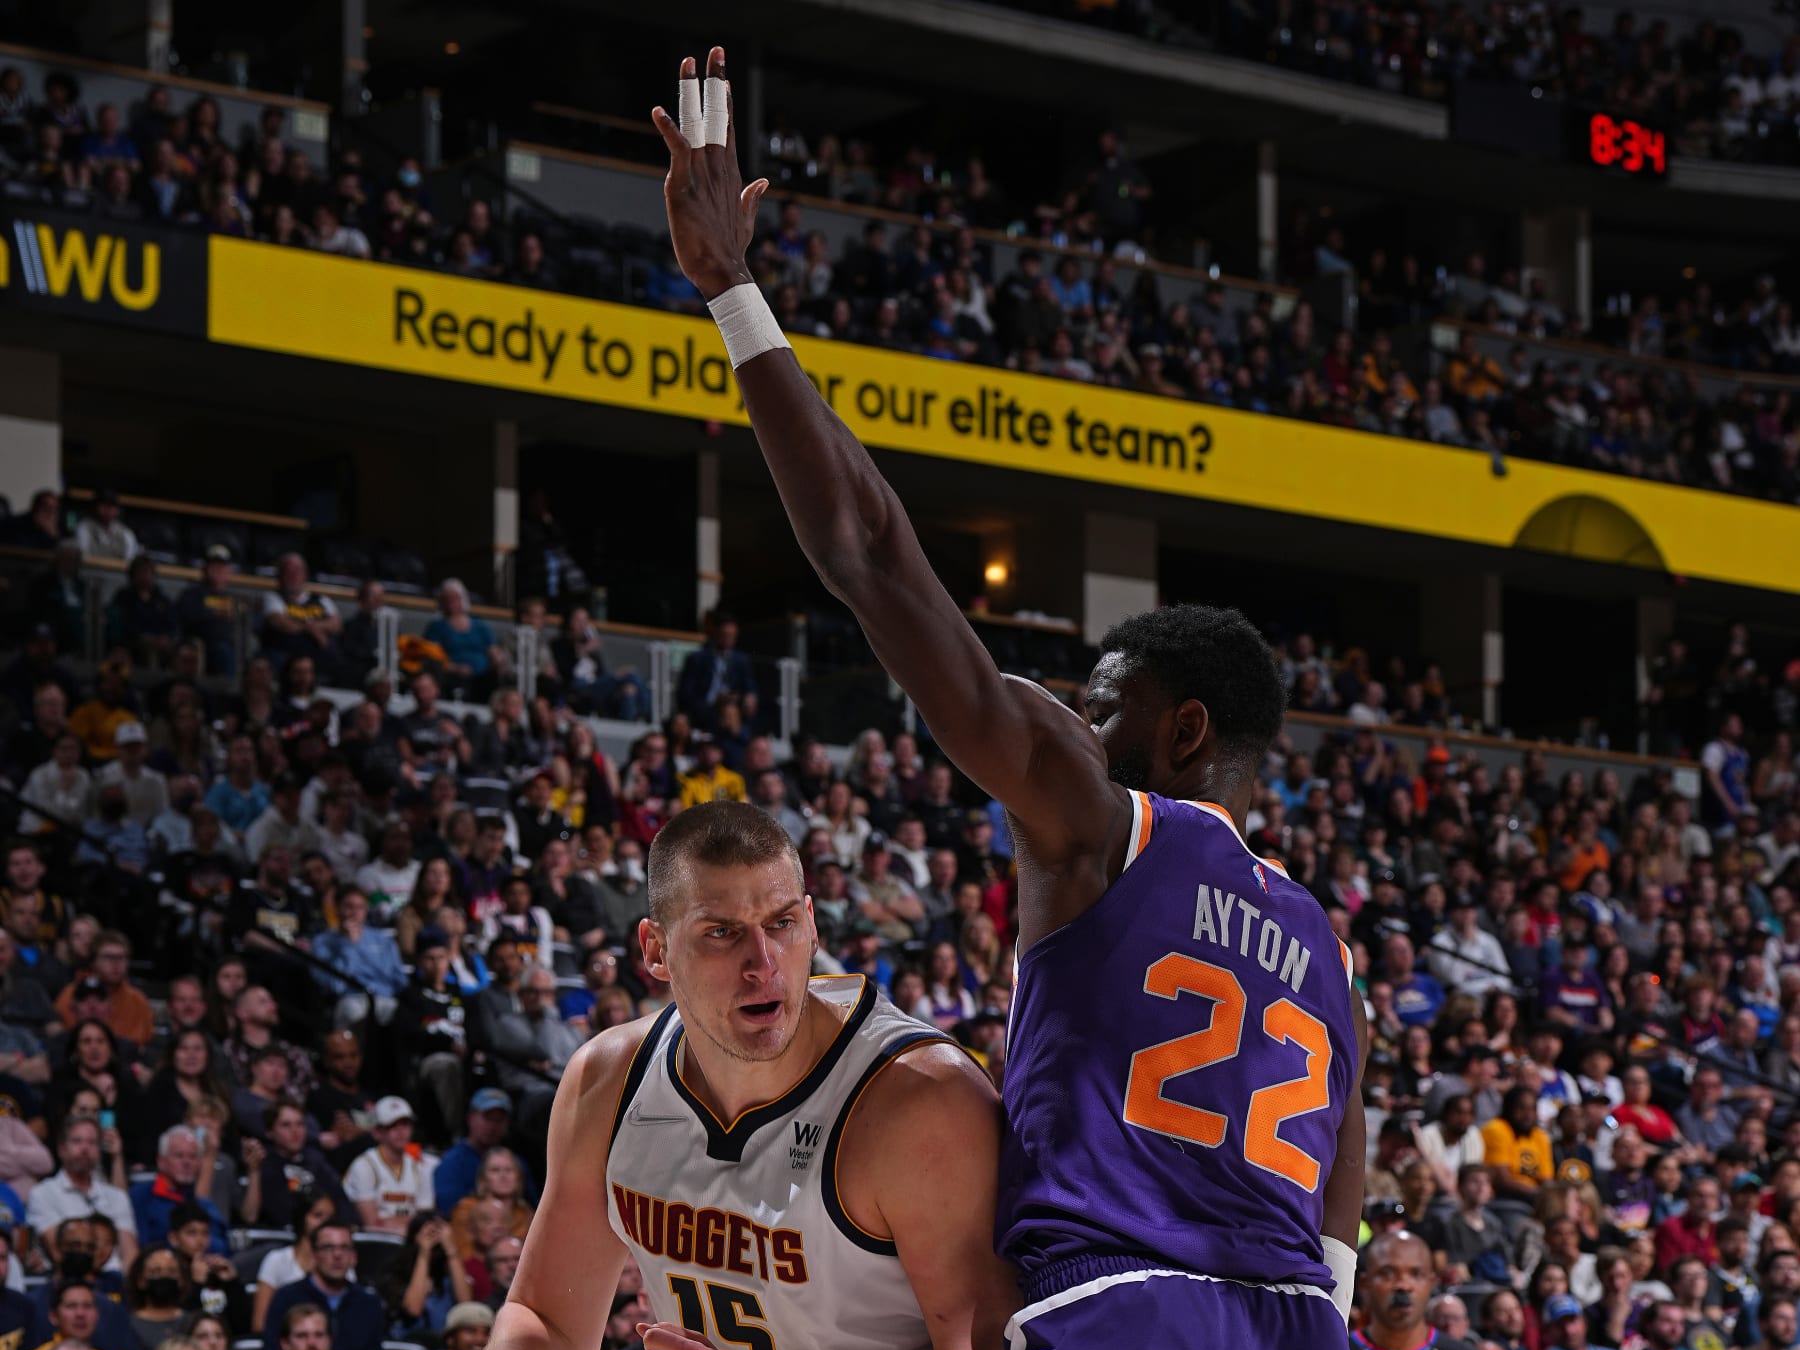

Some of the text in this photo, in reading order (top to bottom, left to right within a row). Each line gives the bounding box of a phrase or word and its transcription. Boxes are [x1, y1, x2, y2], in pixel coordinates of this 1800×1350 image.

[1590, 113, 1665, 174] 8:34
[37, 224, 161, 310] WU
[394, 288, 565, 381] Ready
[579, 325, 633, 379] to
[650, 336, 746, 411] pla
[856, 380, 936, 427] our
[948, 386, 1052, 447] elite
[1065, 408, 1212, 473] team?
[1193, 884, 1311, 993] AYTON
[1123, 952, 1332, 1194] 22
[612, 1181, 809, 1285] NUGGETS
